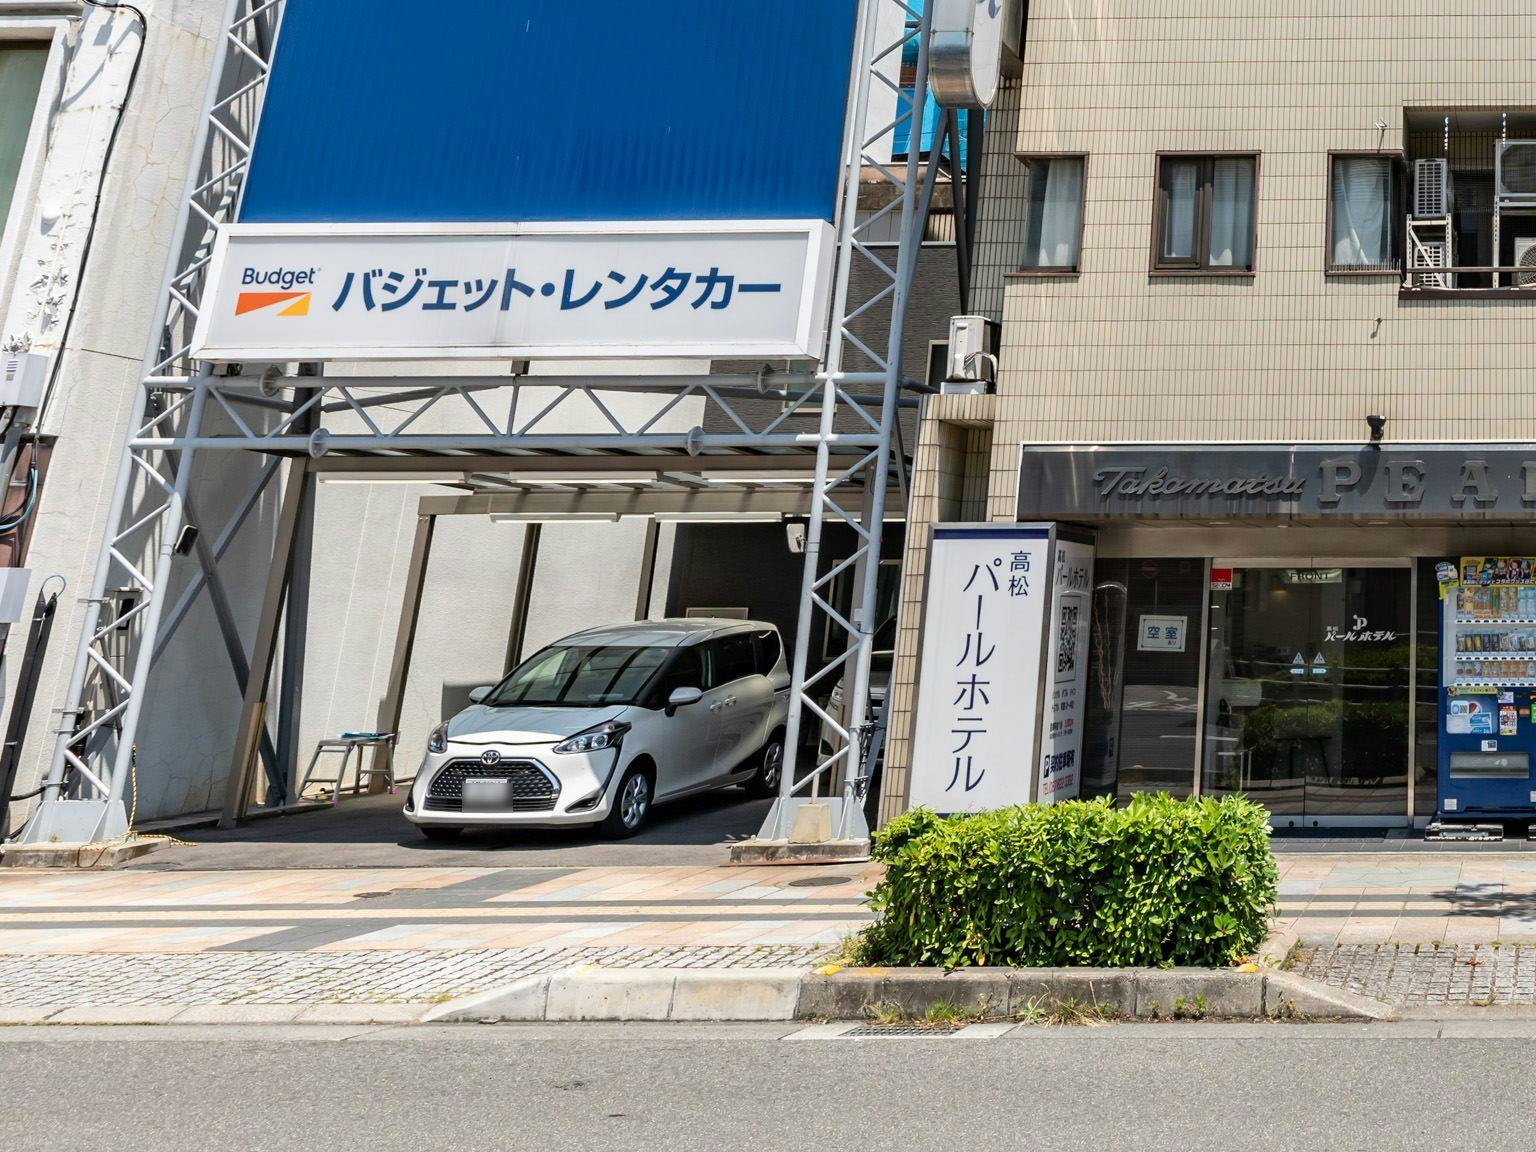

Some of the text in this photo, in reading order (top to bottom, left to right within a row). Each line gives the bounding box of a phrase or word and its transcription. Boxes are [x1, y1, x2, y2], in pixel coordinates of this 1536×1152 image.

[242, 267, 316, 290] Budget
[332, 266, 782, 314] バジェット・レンタカー
[1095, 465, 1305, 496] Takamatsu
[1008, 550, 1032, 597] 高松
[1289, 572, 1329, 581] FRONT
[1324, 630, 1397, 642] パールホテル
[945, 557, 1003, 793] パールホテル
